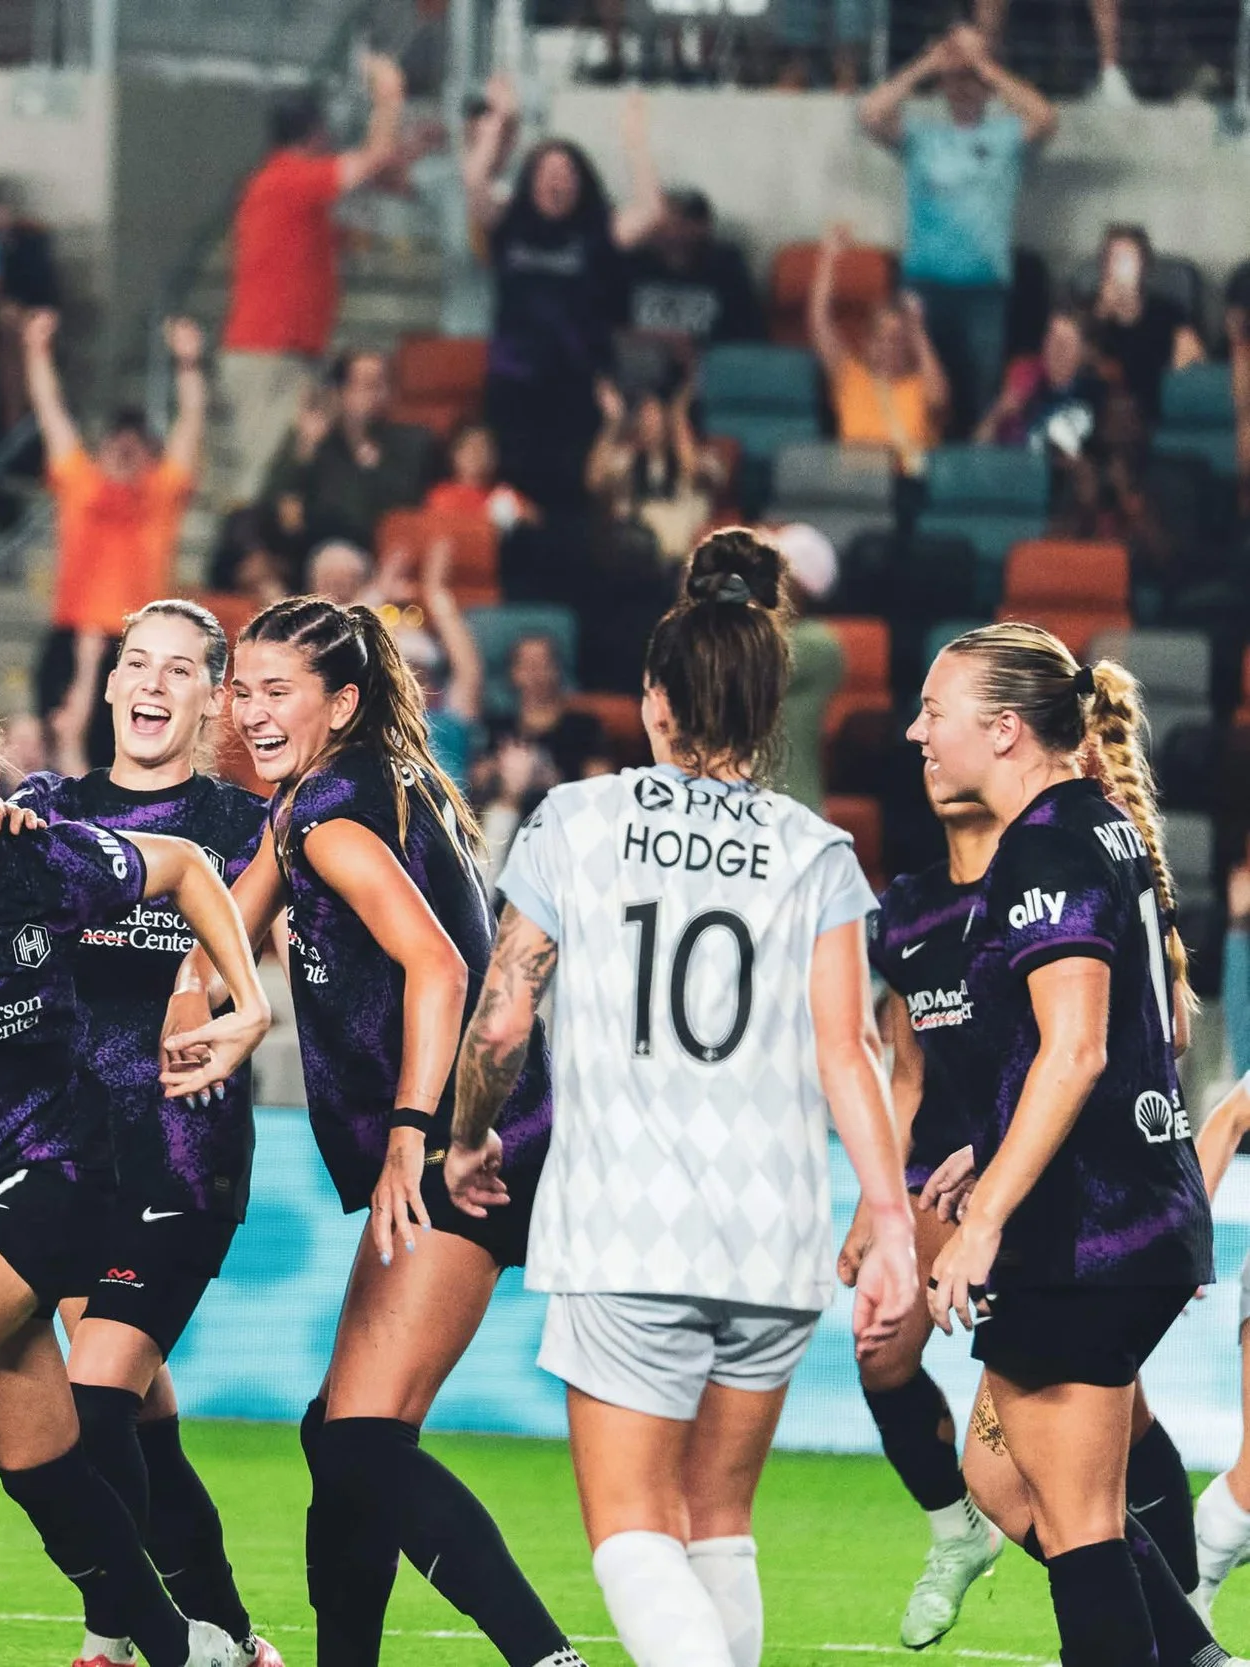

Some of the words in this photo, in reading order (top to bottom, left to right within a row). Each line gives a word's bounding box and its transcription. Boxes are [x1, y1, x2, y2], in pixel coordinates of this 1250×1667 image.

[683, 786, 773, 827] PNC
[624, 822, 770, 881] HODGE
[1008, 887, 1067, 930] ally
[621, 896, 756, 1067] 10
